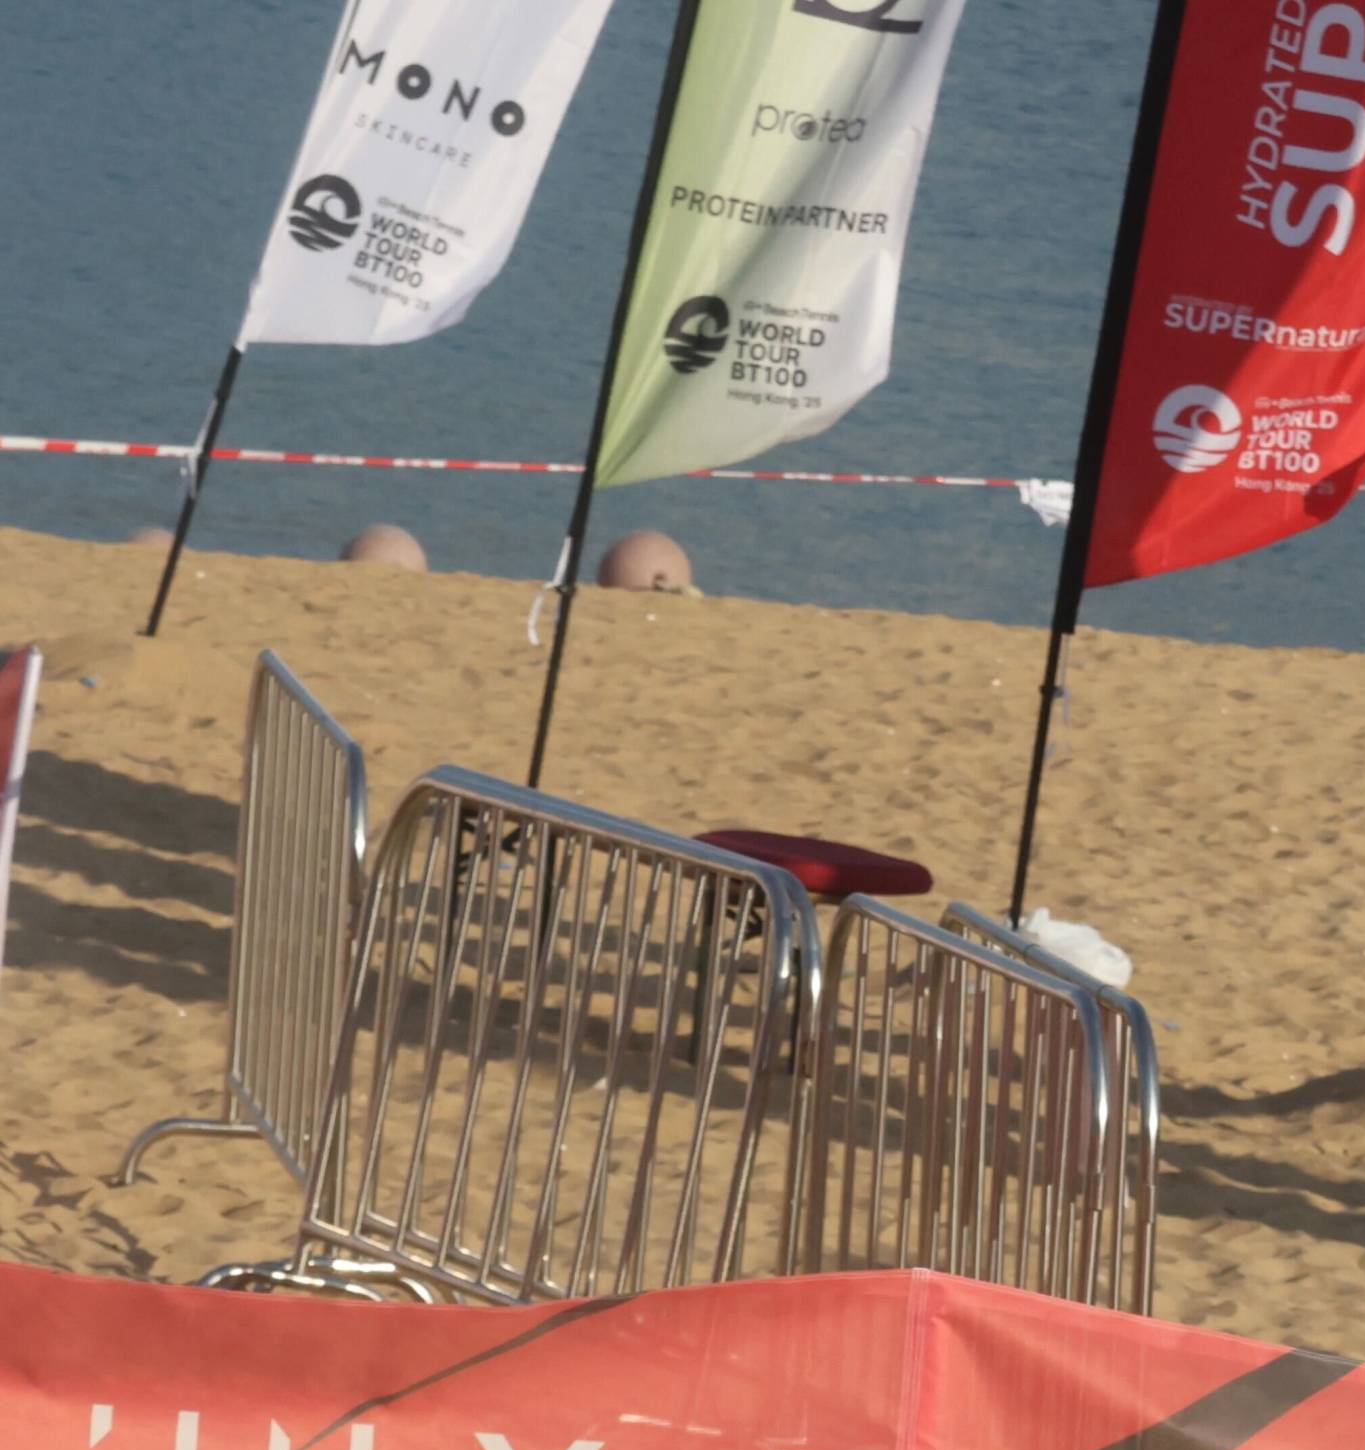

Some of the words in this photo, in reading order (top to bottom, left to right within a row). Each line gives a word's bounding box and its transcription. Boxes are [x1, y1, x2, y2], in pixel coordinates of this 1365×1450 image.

[339, 38, 525, 137] MONO
[354, 112, 473, 169] SKINCARE
[751, 104, 867, 143] protea
[671, 186, 779, 229] PROTEIN
[778, 204, 889, 235] PARTNER
[364, 231, 422, 268] TOUR
[371, 212, 448, 256] WORLD
[353, 250, 424, 289] BT100
[739, 319, 826, 348] WORLD
[735, 340, 801, 367] TOUR
[730, 361, 808, 388] BT100
[1251, 409, 1339, 432] WORLD
[1246, 429, 1312, 450] TOUR
[1237, 450, 1321, 474] BT100
